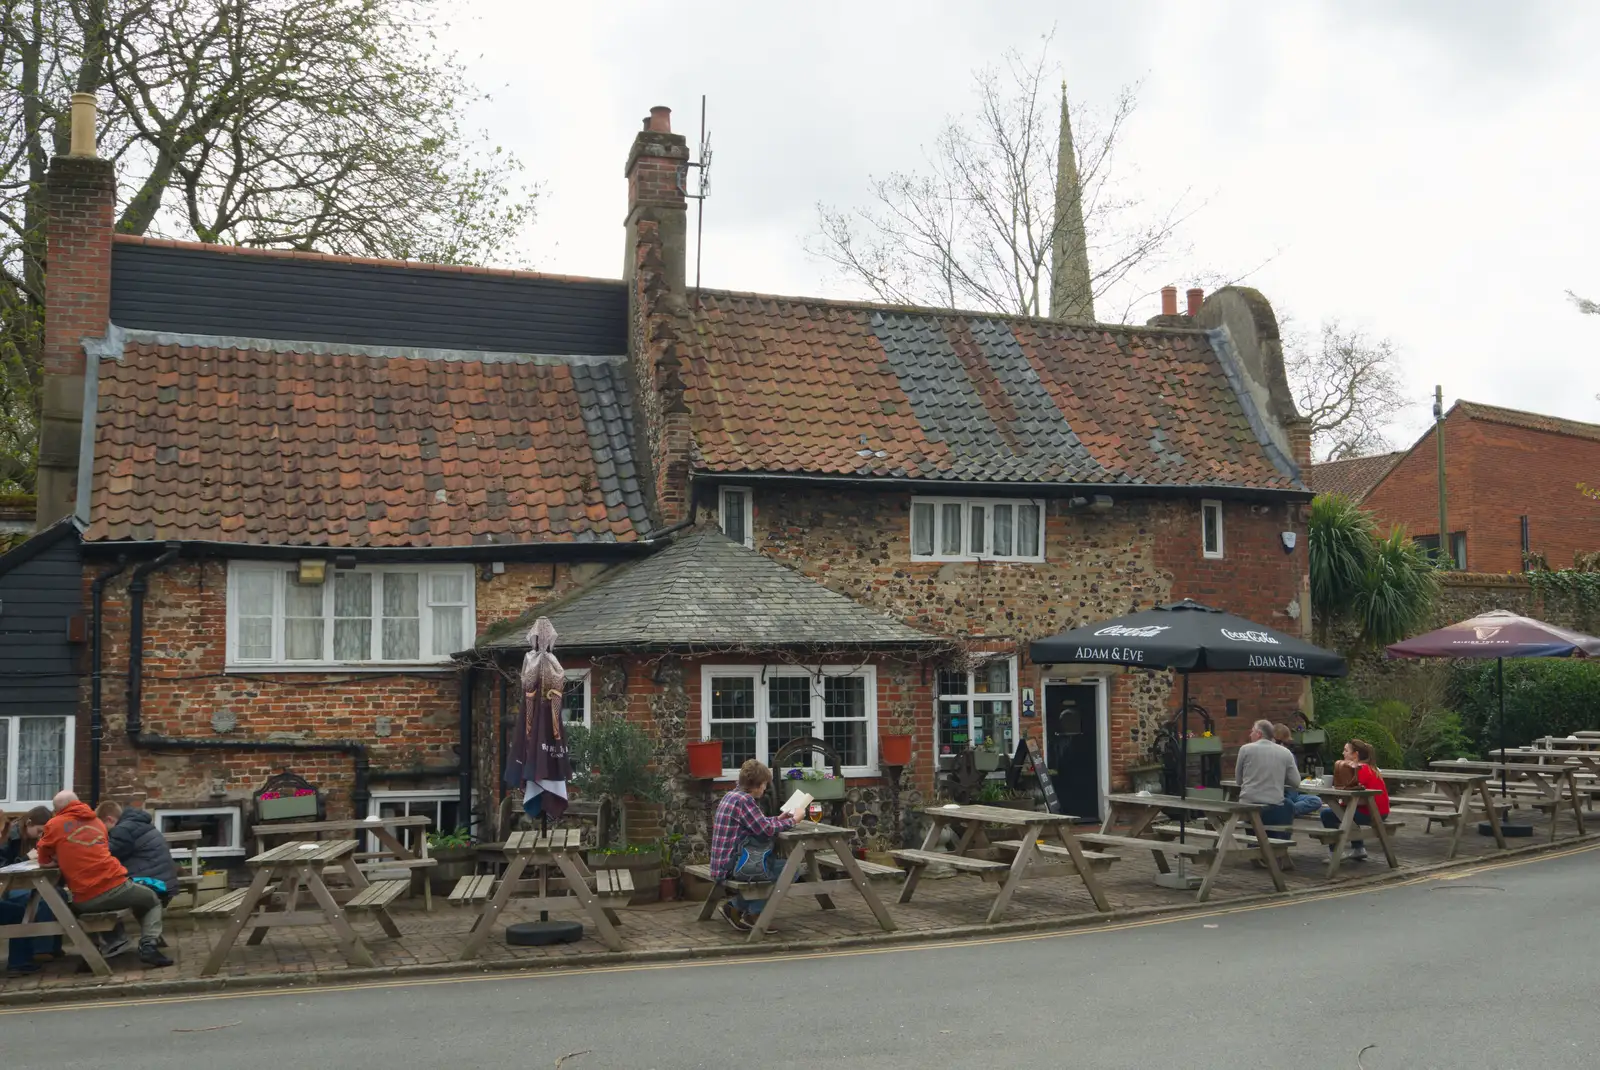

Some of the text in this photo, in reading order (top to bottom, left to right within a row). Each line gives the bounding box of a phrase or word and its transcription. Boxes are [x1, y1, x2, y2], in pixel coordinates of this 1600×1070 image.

[1221, 628, 1279, 644] Coca-Cola
[1075, 646, 1144, 662] ADAM & EVE
[1248, 654, 1305, 669] ADAM & EVE
